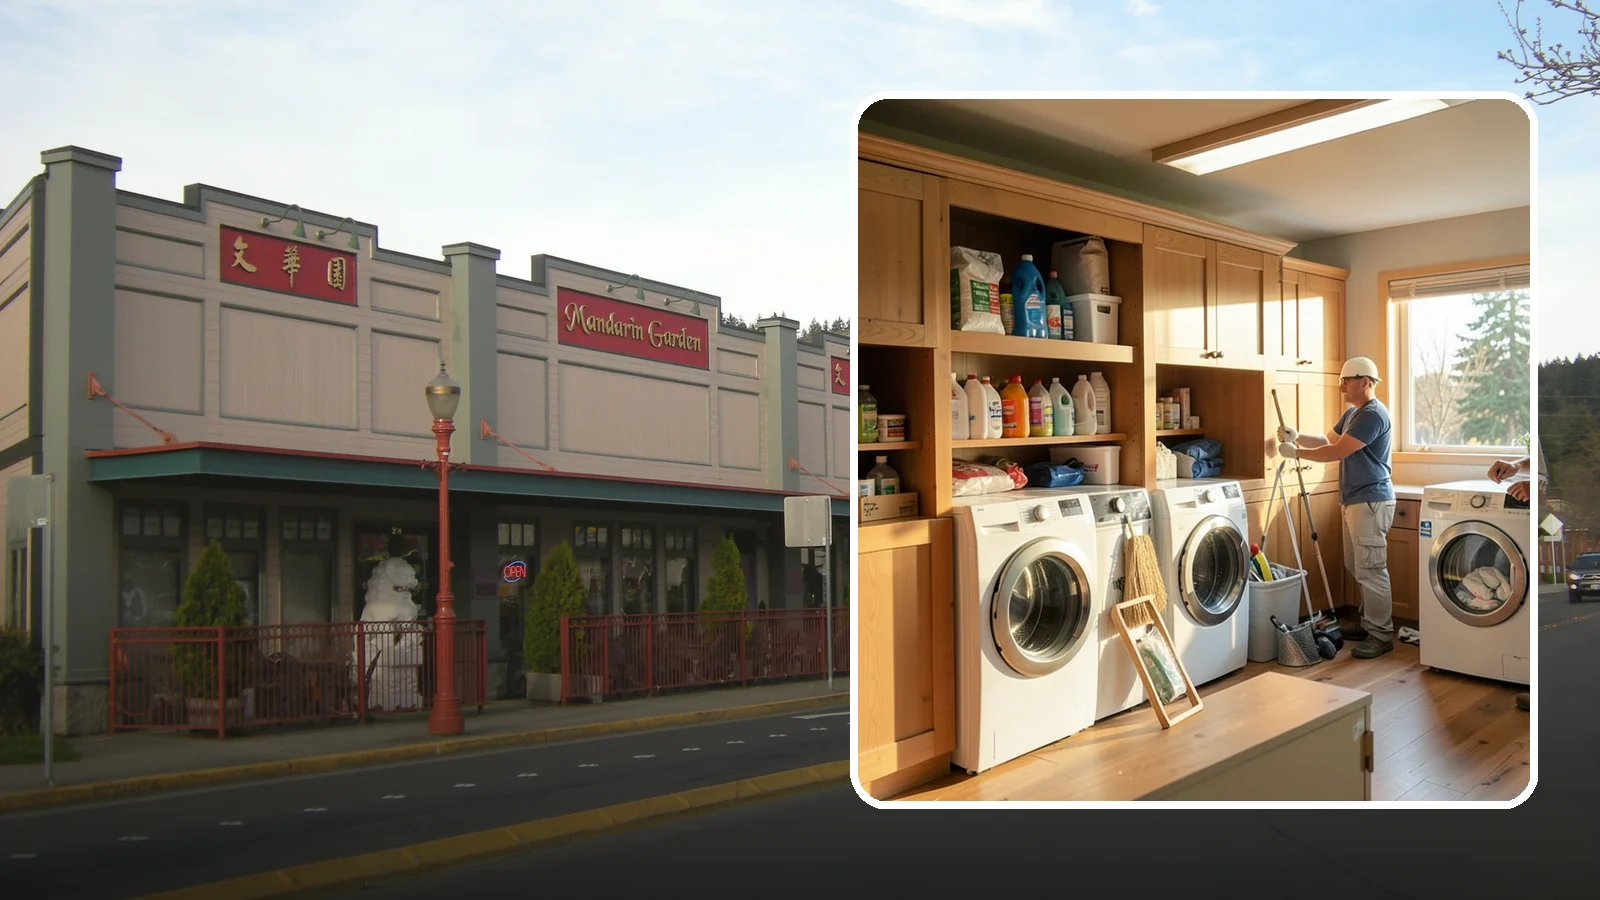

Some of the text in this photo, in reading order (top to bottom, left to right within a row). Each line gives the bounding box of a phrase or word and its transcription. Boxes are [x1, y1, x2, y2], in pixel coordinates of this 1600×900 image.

[231, 235, 346, 291] 文華園
[564, 302, 701, 352] Mandarin Garden
[503, 565, 527, 578] OPEN
